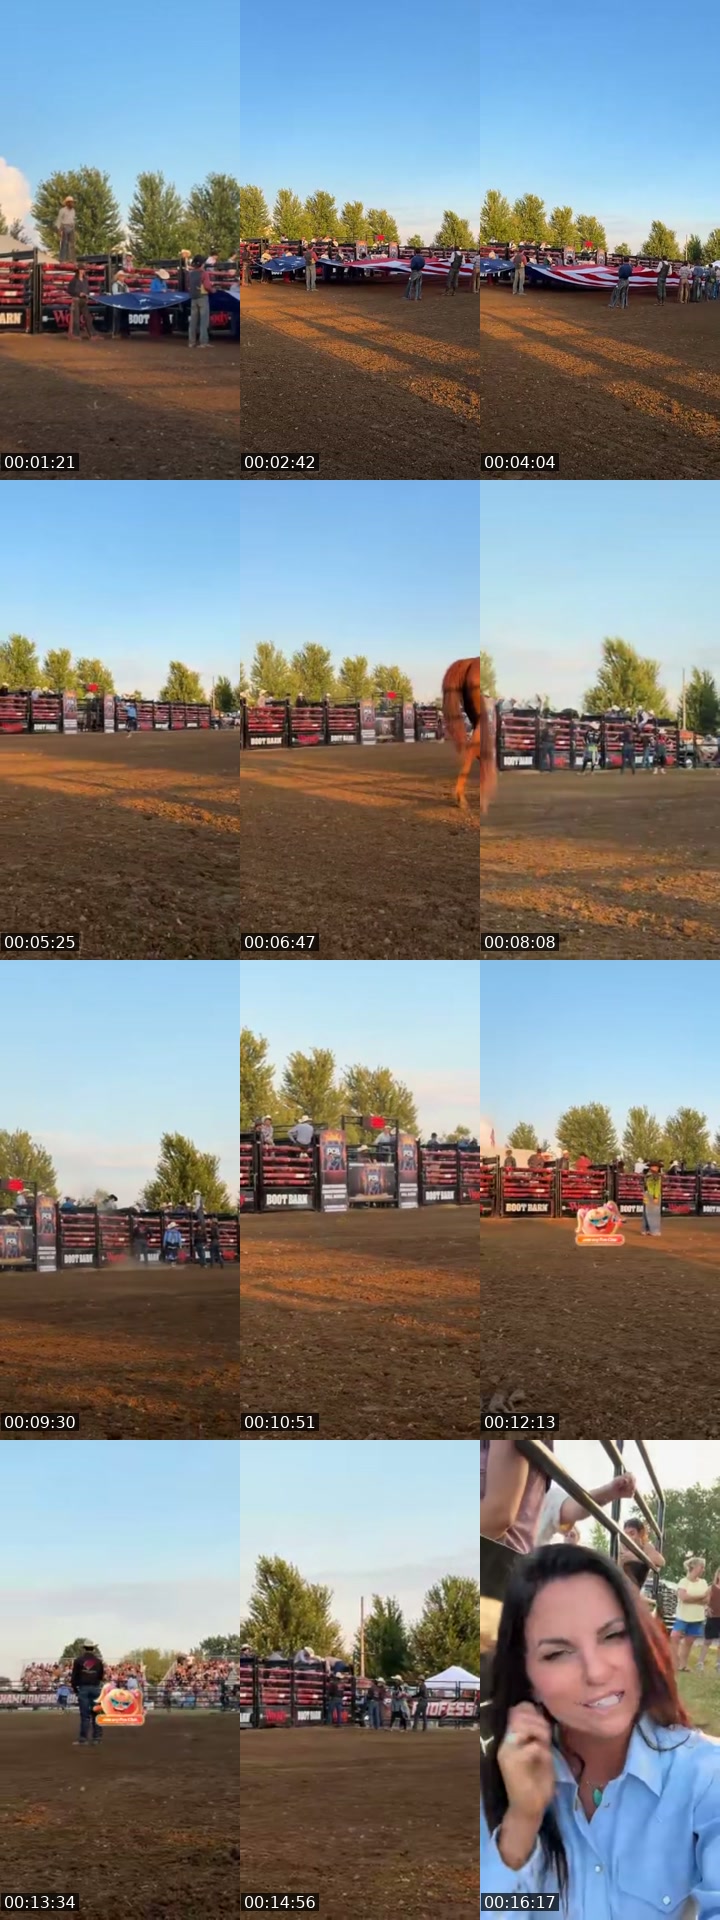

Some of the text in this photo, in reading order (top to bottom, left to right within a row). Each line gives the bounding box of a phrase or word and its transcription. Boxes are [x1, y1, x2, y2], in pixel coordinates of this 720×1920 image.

[128, 313, 150, 324] BOOT
[266, 1194, 308, 1205] BOOT BARN
[506, 1203, 548, 1212] BOOT BARN
[0, 1693, 57, 1704] HAMPIONSHIP
